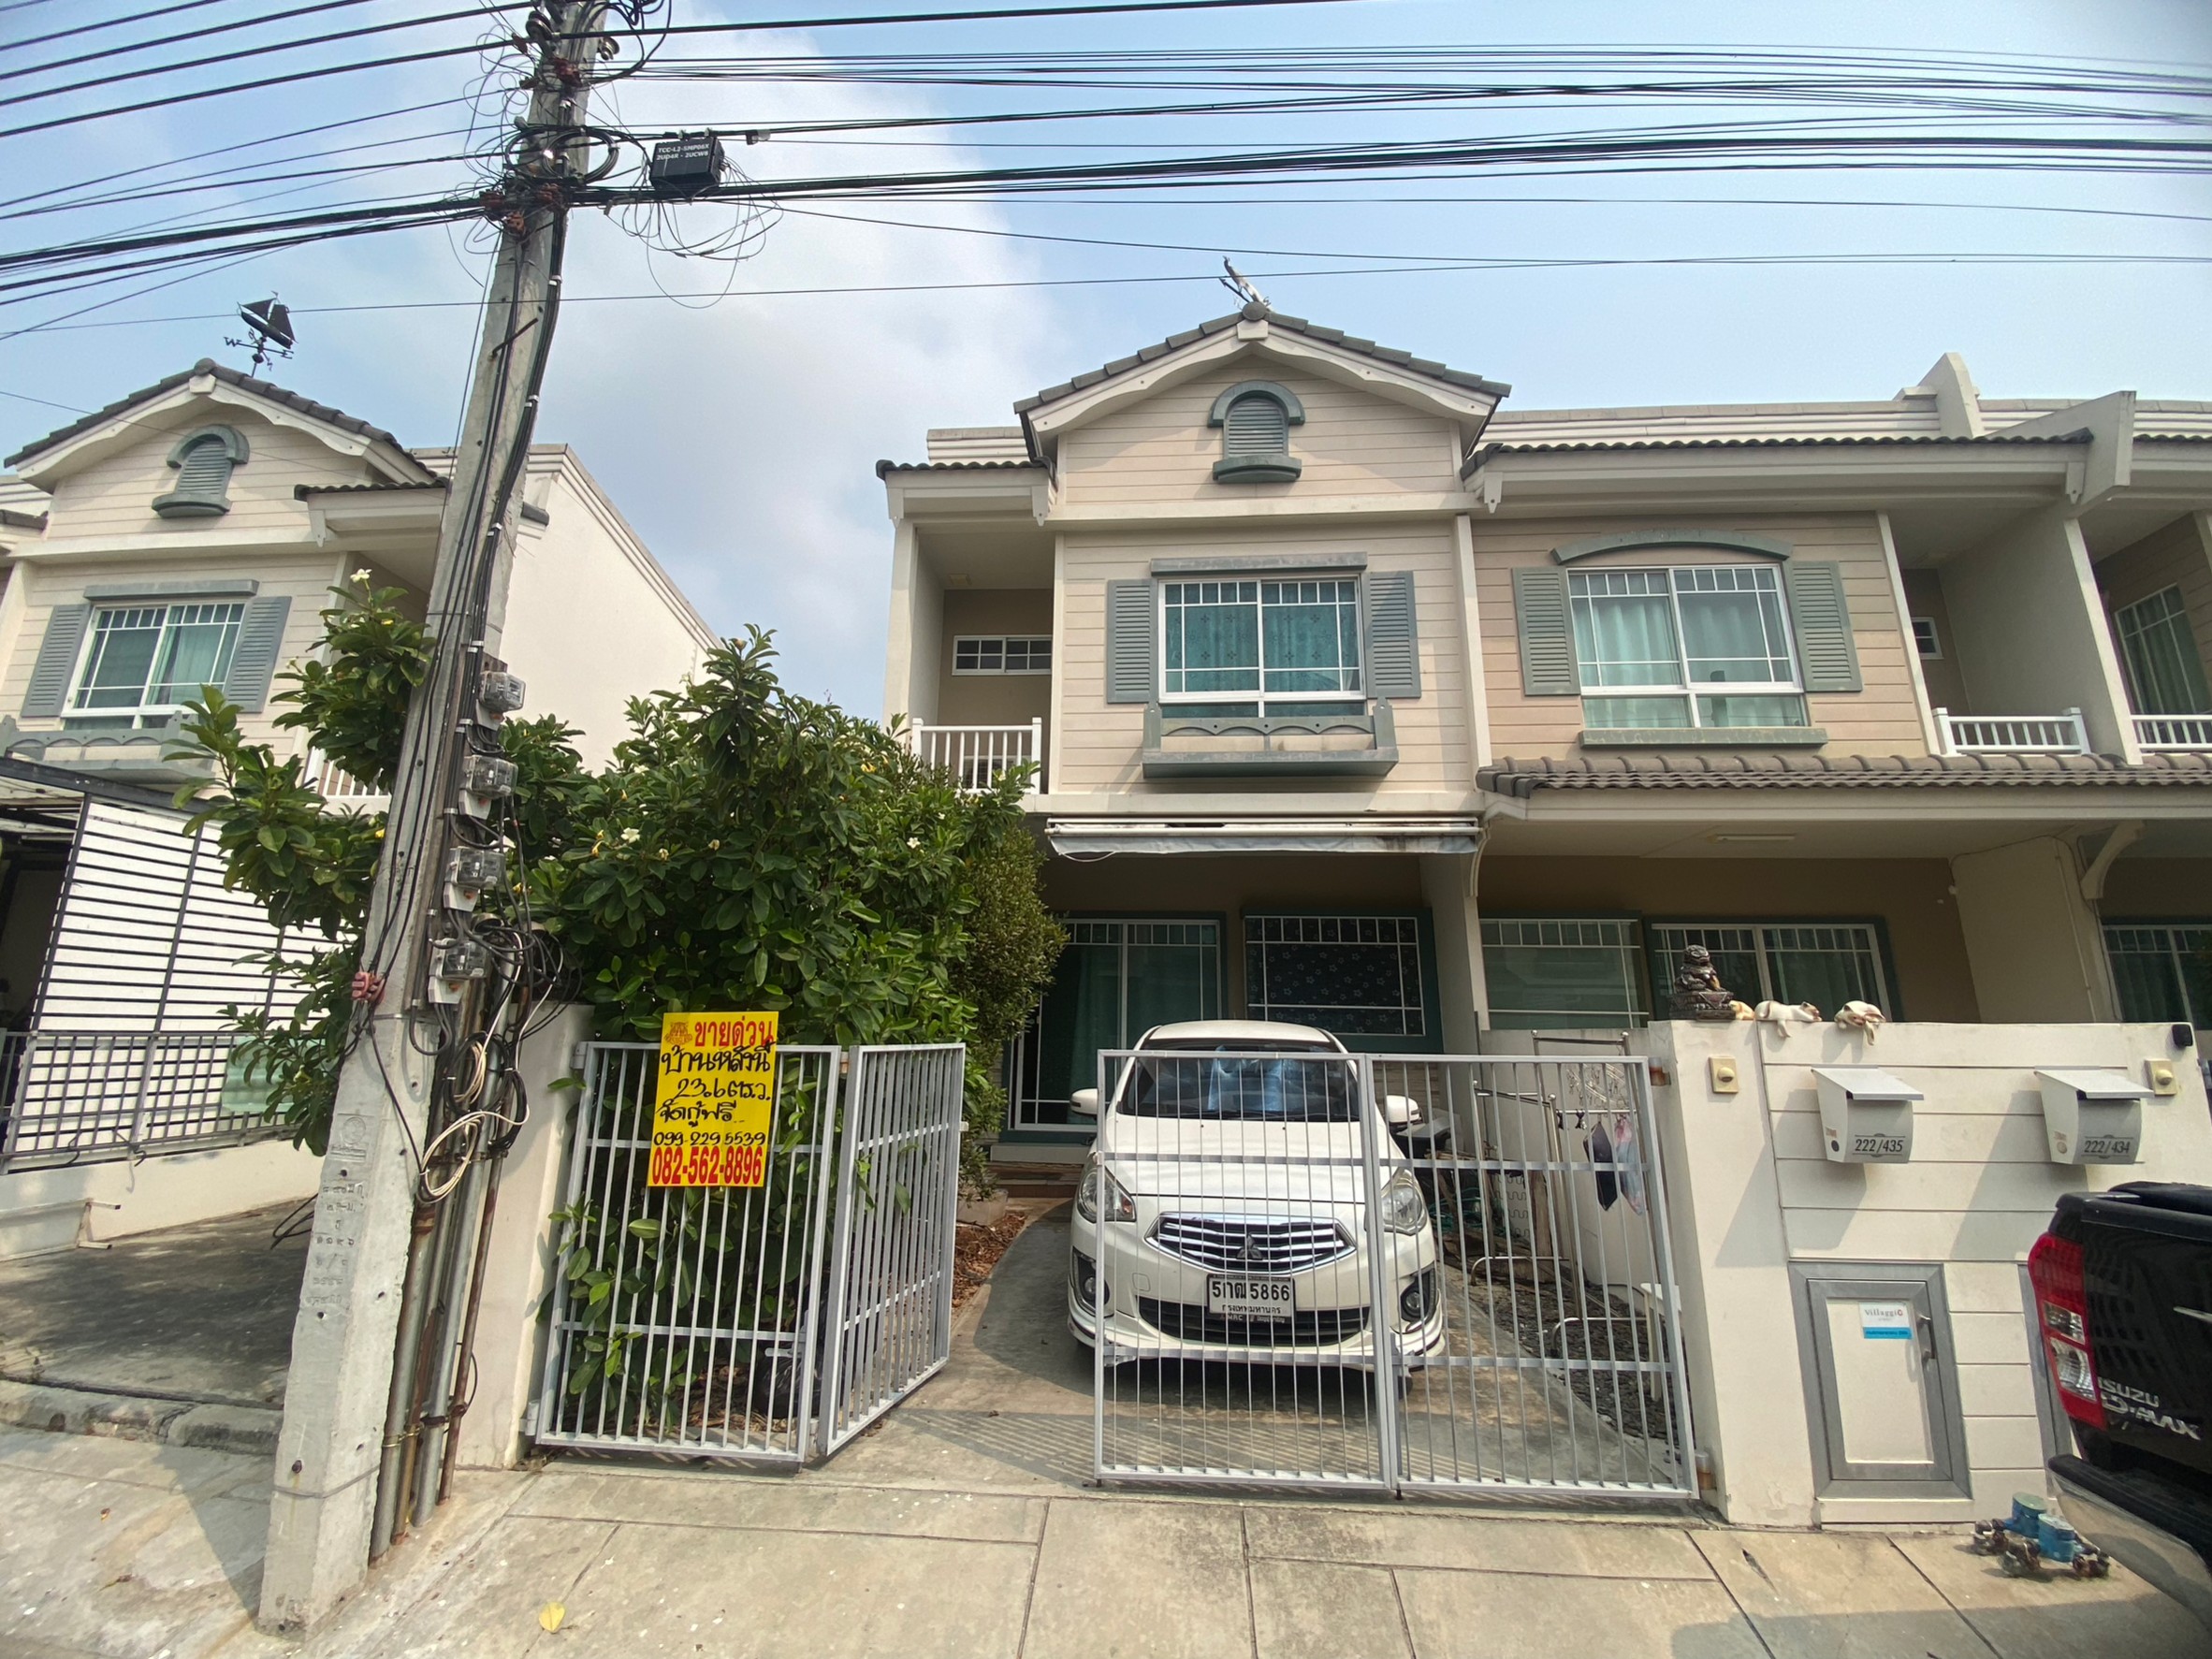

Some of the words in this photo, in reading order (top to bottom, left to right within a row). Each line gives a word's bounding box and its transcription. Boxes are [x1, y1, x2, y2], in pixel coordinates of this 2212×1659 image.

[694, 1015, 776, 1047] ขายด่วน
[661, 1041, 776, 1075] บ้านหลังนี้
[1855, 1139, 1903, 1154] 222/435
[2084, 1141, 2131, 1154] 222/434
[652, 1145, 763, 1186] 082-562-8896
[1250, 1283, 1290, 1302] 5866
[2098, 1376, 2160, 1408] ISUZU
